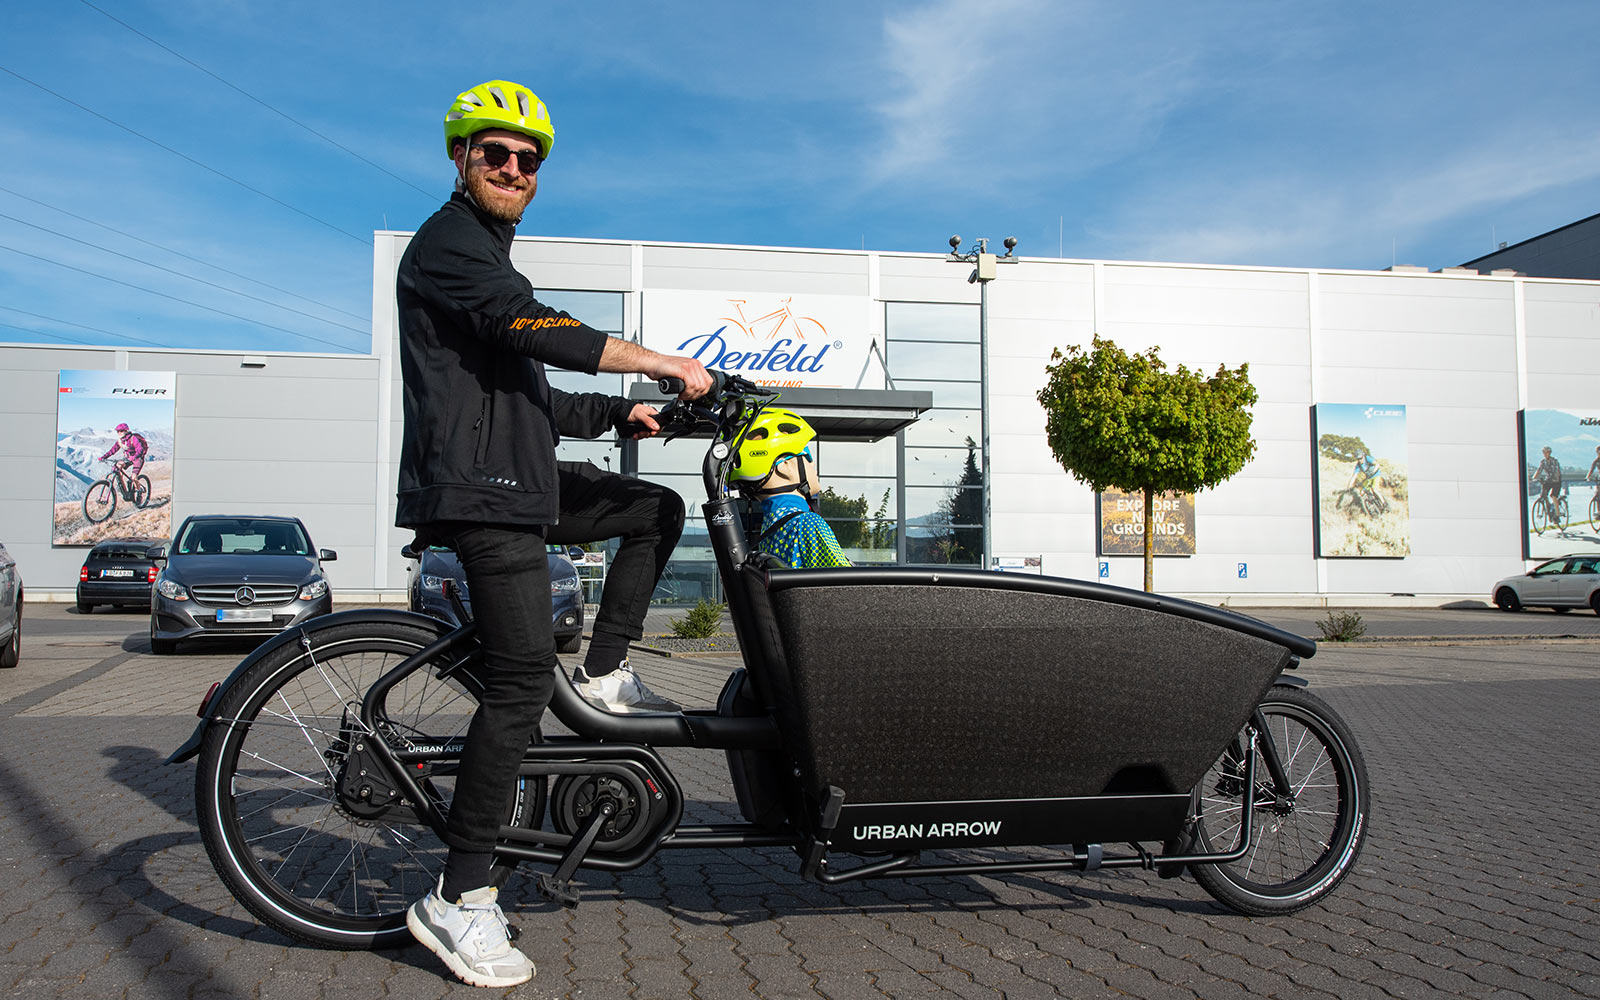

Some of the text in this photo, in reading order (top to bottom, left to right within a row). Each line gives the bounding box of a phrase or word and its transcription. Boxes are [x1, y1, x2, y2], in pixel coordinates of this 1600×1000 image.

[676, 326, 830, 373] Denfeld
[1117, 499, 1180, 511] EXPORE
[1132, 511, 1165, 523] NW
[1113, 523, 1185, 535] GRONDS
[408, 745, 444, 753] URBAN
[853, 821, 1001, 840] URBAN ARROW
